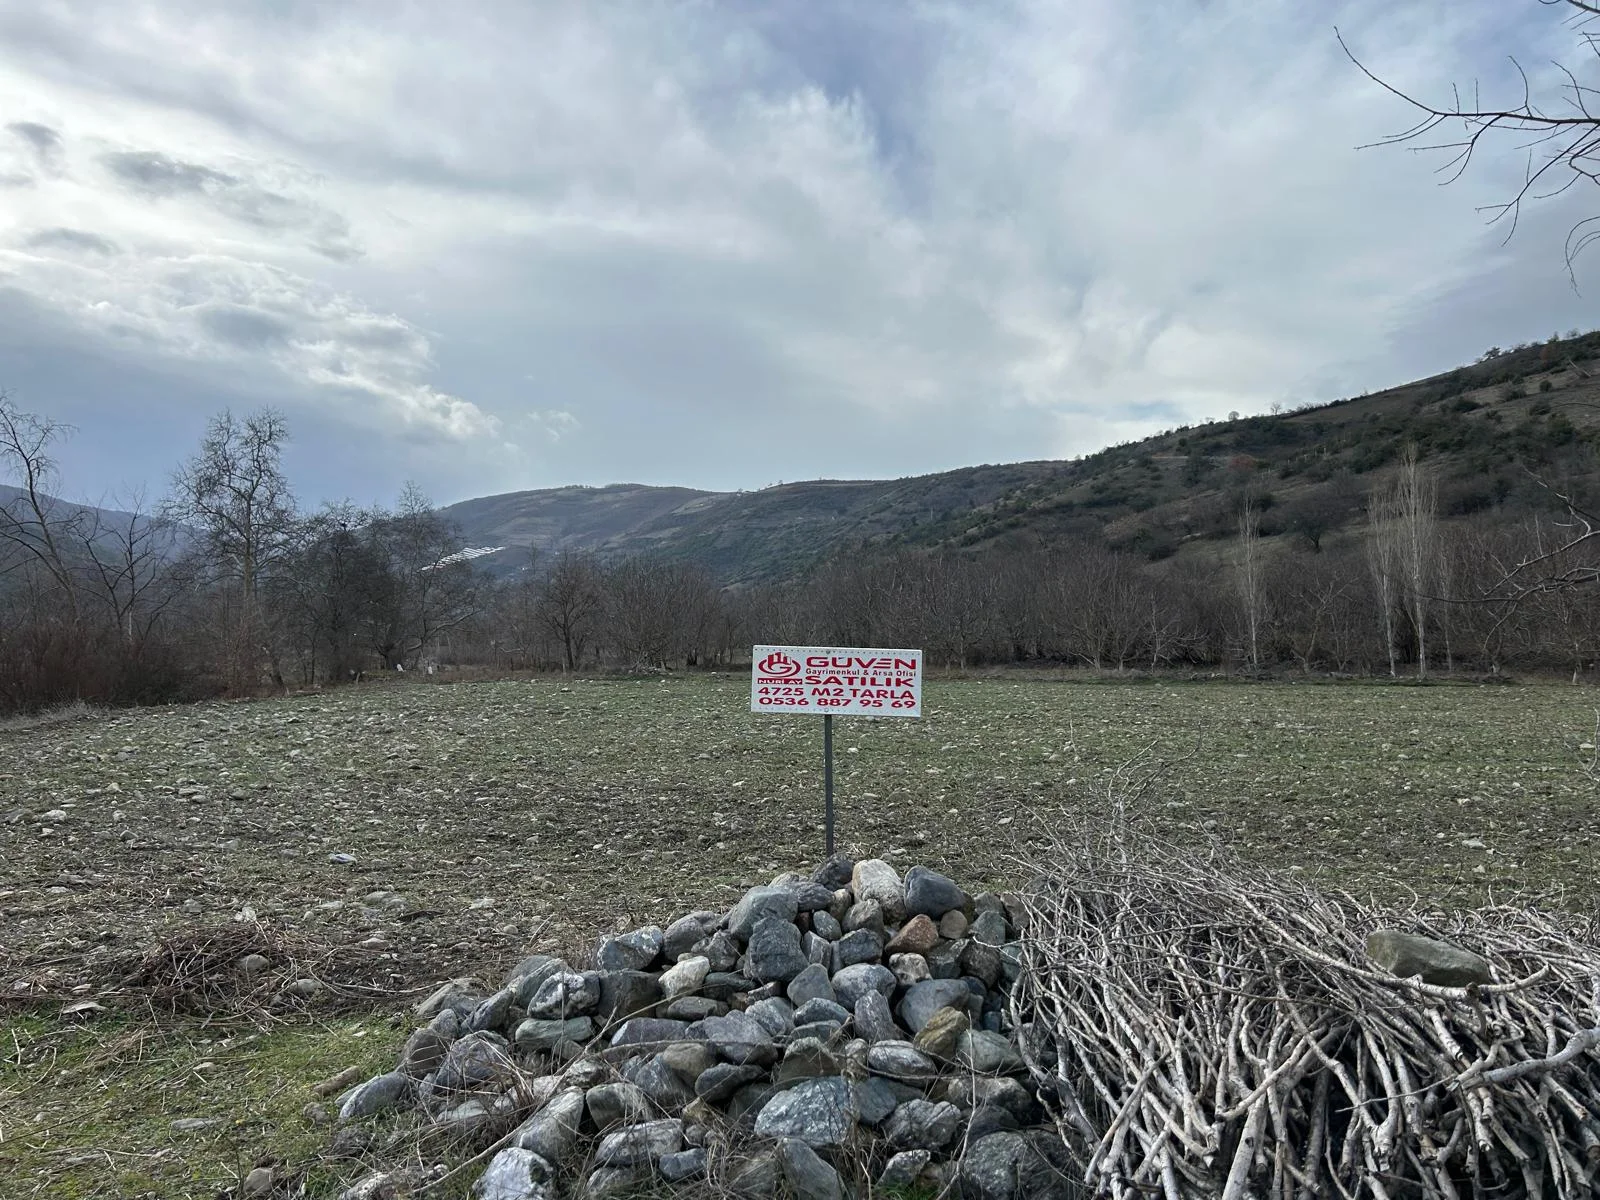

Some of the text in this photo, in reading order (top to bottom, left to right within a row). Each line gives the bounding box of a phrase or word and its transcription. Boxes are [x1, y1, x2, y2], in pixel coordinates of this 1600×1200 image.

[806, 656, 916, 669] GÜVEN
[805, 668, 860, 677] Gayrimenkul
[805, 676, 914, 687] SATILIK
[758, 687, 914, 699] 4725 M2 TARLA
[759, 697, 915, 709] 0536 887 95 69
